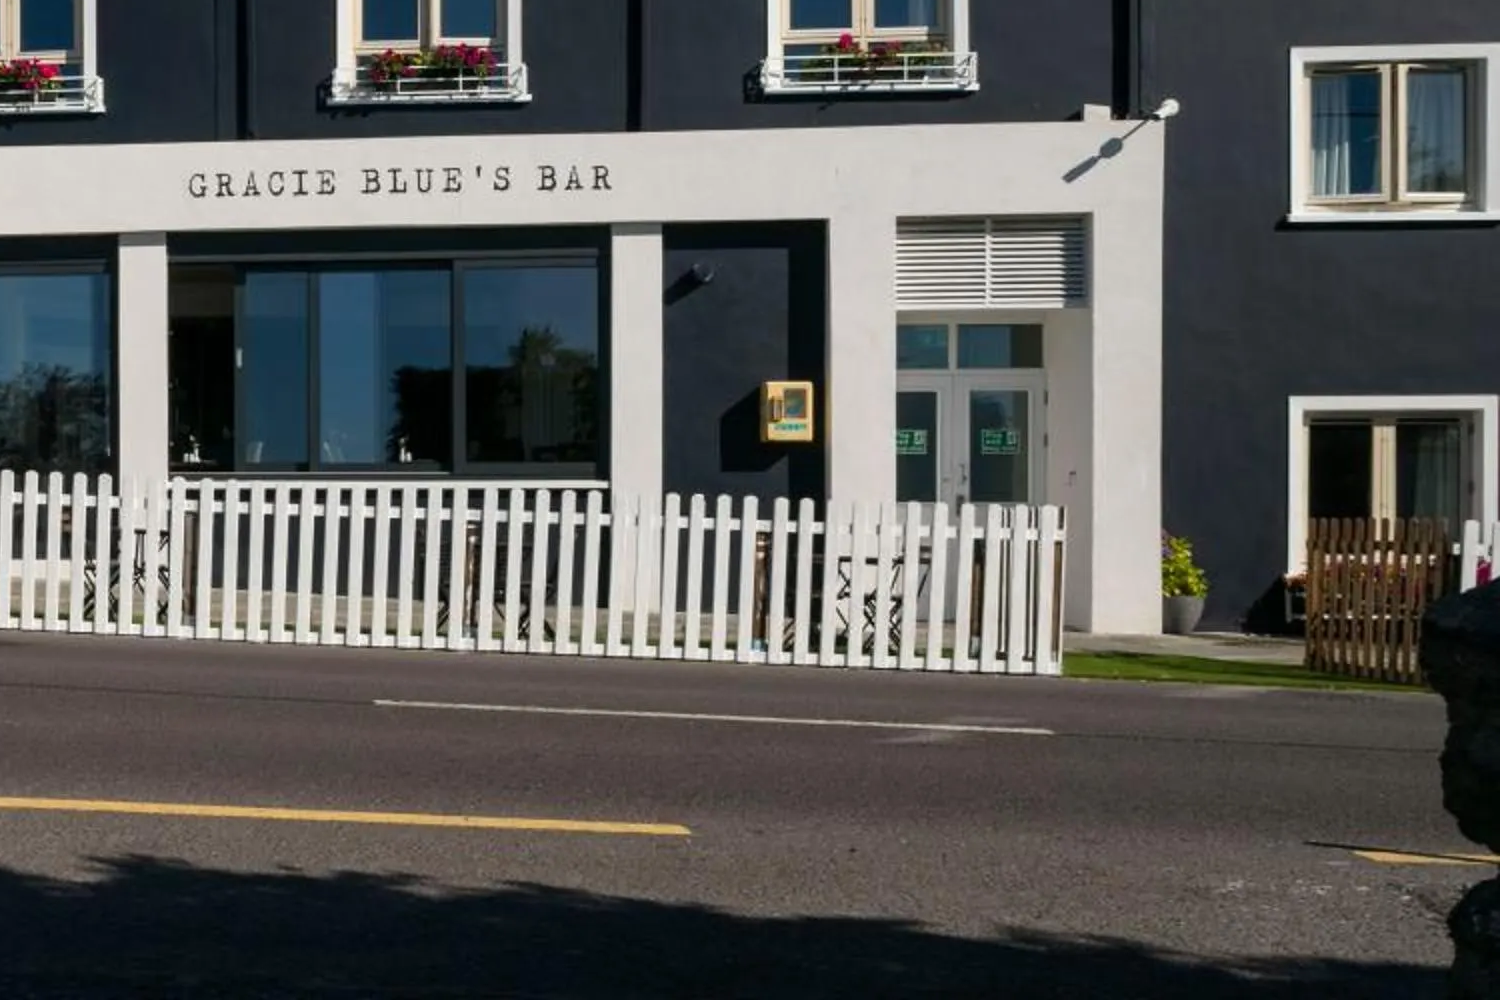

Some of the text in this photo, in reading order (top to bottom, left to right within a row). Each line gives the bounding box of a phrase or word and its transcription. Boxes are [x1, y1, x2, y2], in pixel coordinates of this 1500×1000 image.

[187, 164, 614, 199] GRACIE BLUE'S BAR
